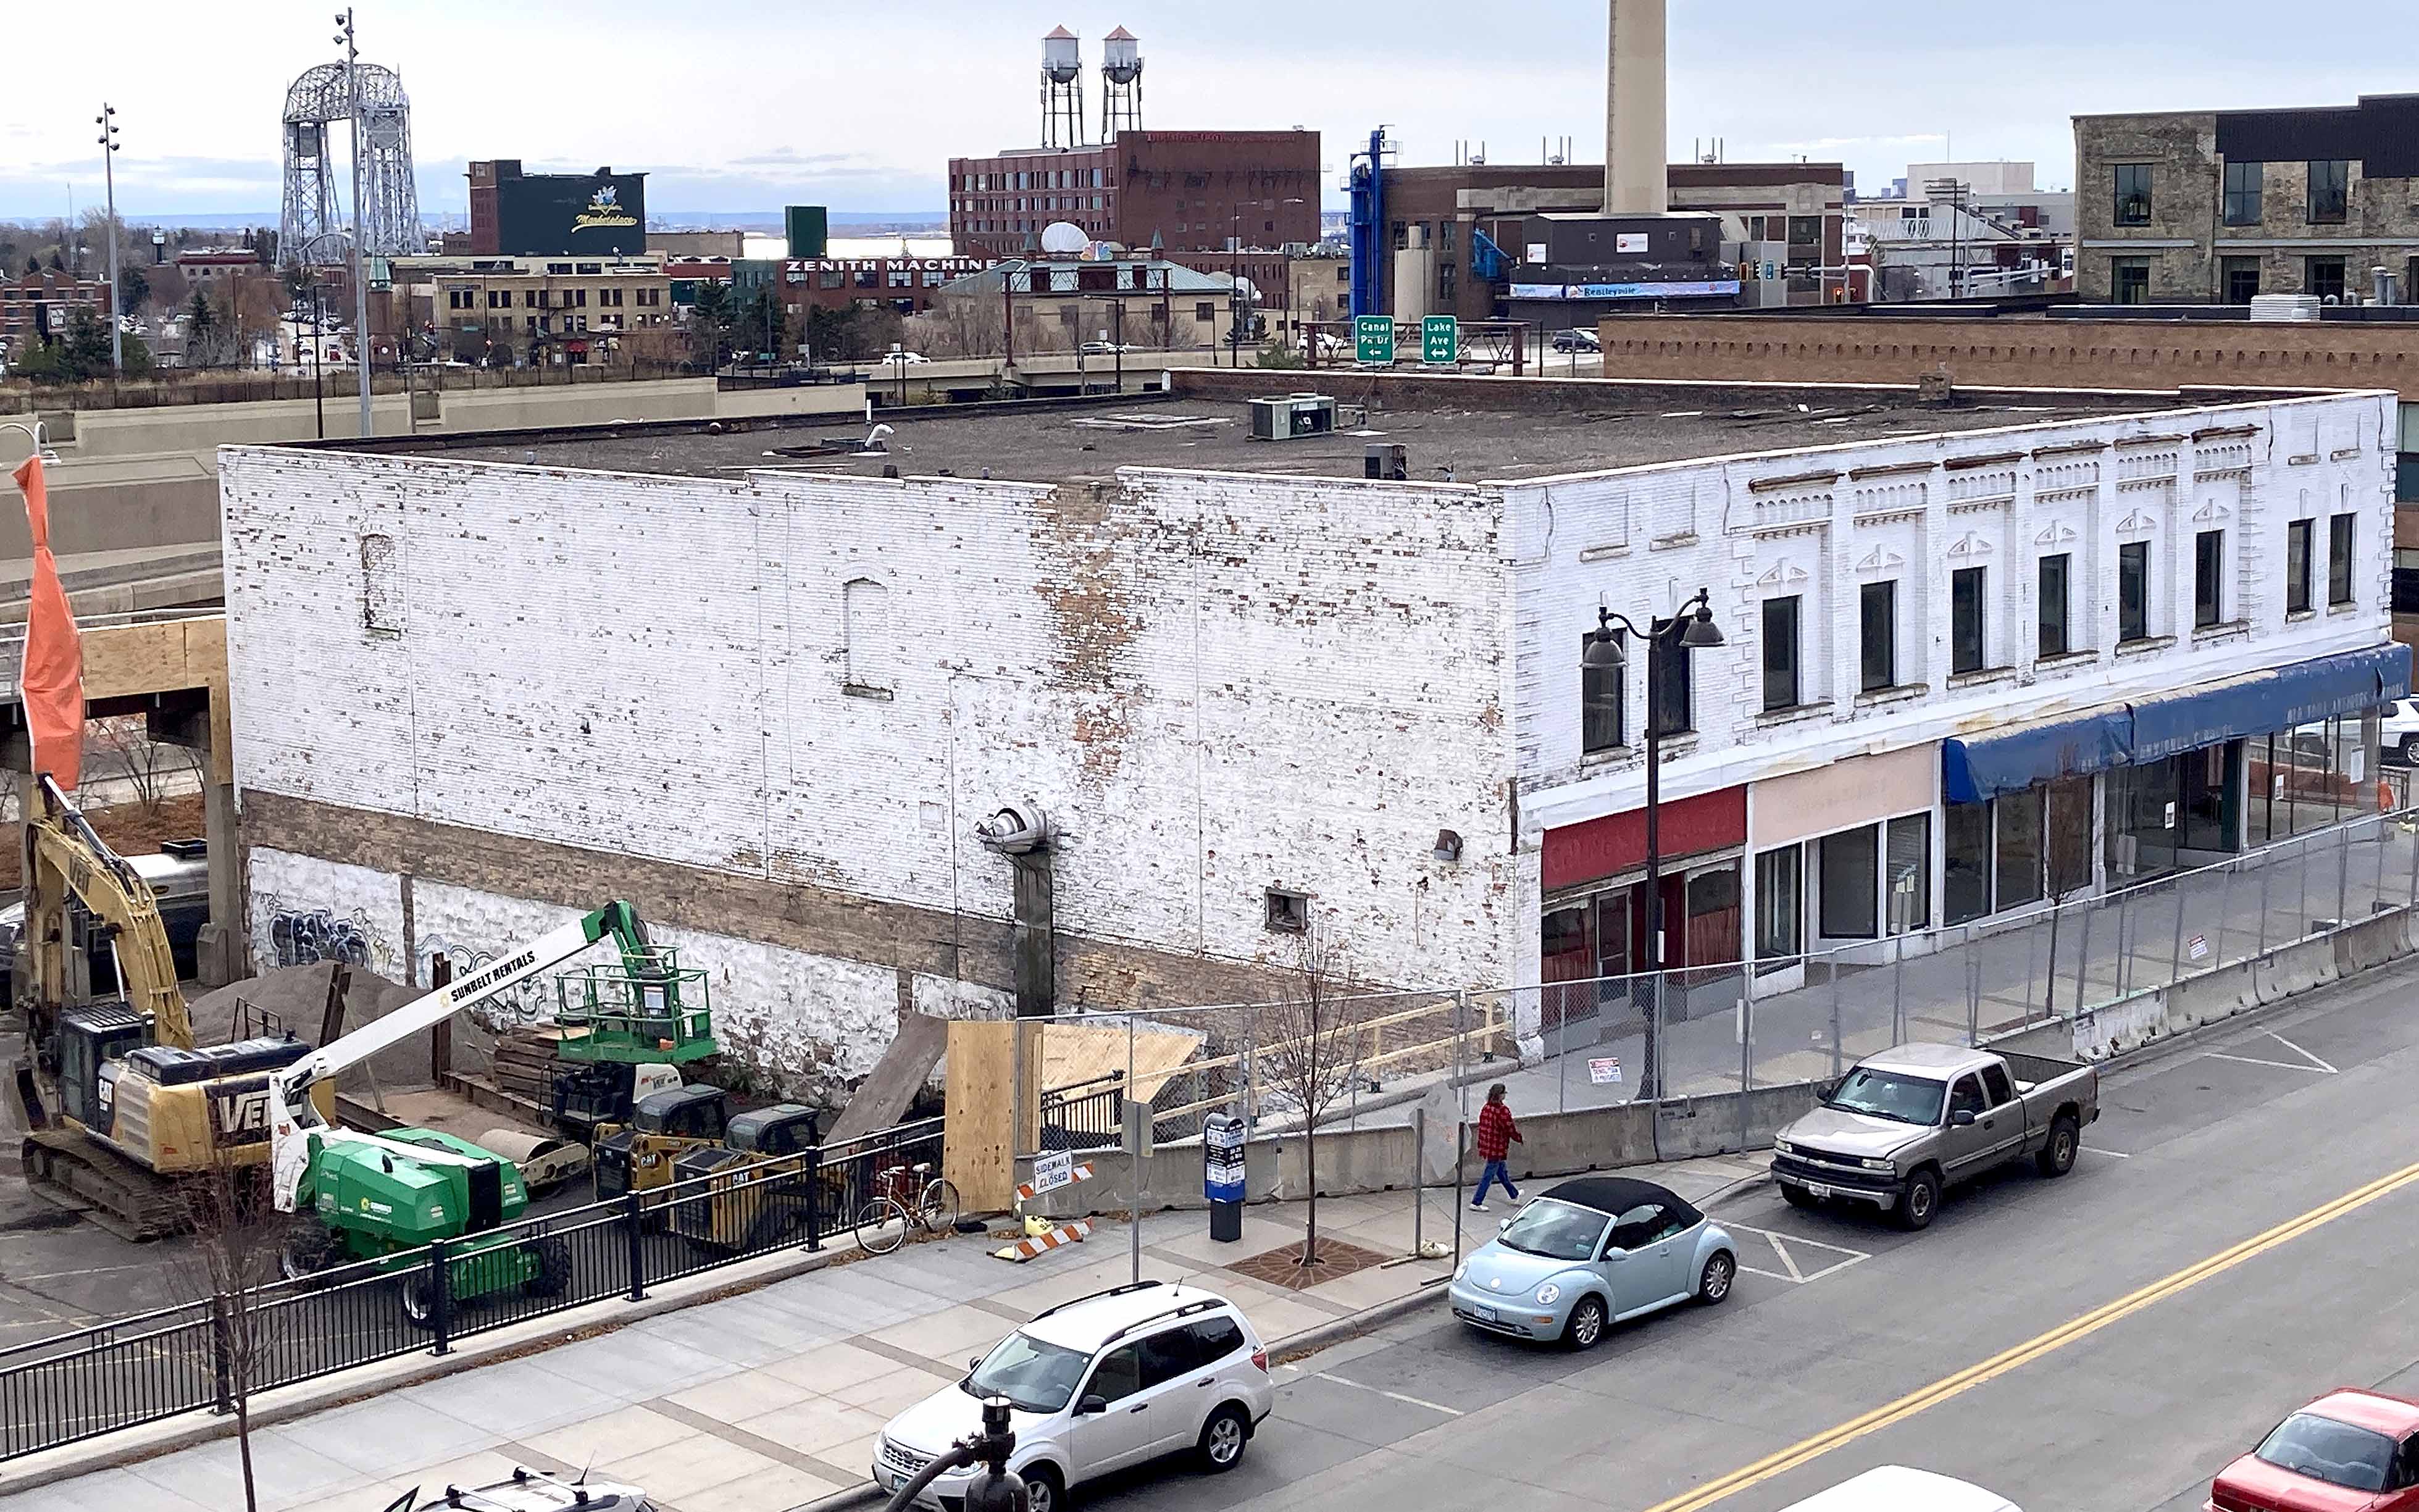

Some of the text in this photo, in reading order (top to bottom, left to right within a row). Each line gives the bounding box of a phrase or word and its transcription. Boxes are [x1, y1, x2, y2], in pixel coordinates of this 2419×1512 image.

[786, 259, 998, 272] ZENITH MACHINE
[1361, 322, 1389, 332] Canal
[1427, 322, 1451, 332] Lake
[1377, 336, 1389, 344] Dr
[1430, 335, 1449, 345] Ave
[451, 972, 492, 1003] SUNBELT
[492, 950, 536, 982] RENTALS
[99, 1078, 113, 1103] CAT
[641, 1153, 656, 1167] CAT
[1036, 1156, 1071, 1175] SIDEWALK
[732, 1171, 750, 1185] CAT
[1040, 1171, 1068, 1188] CLOSED
